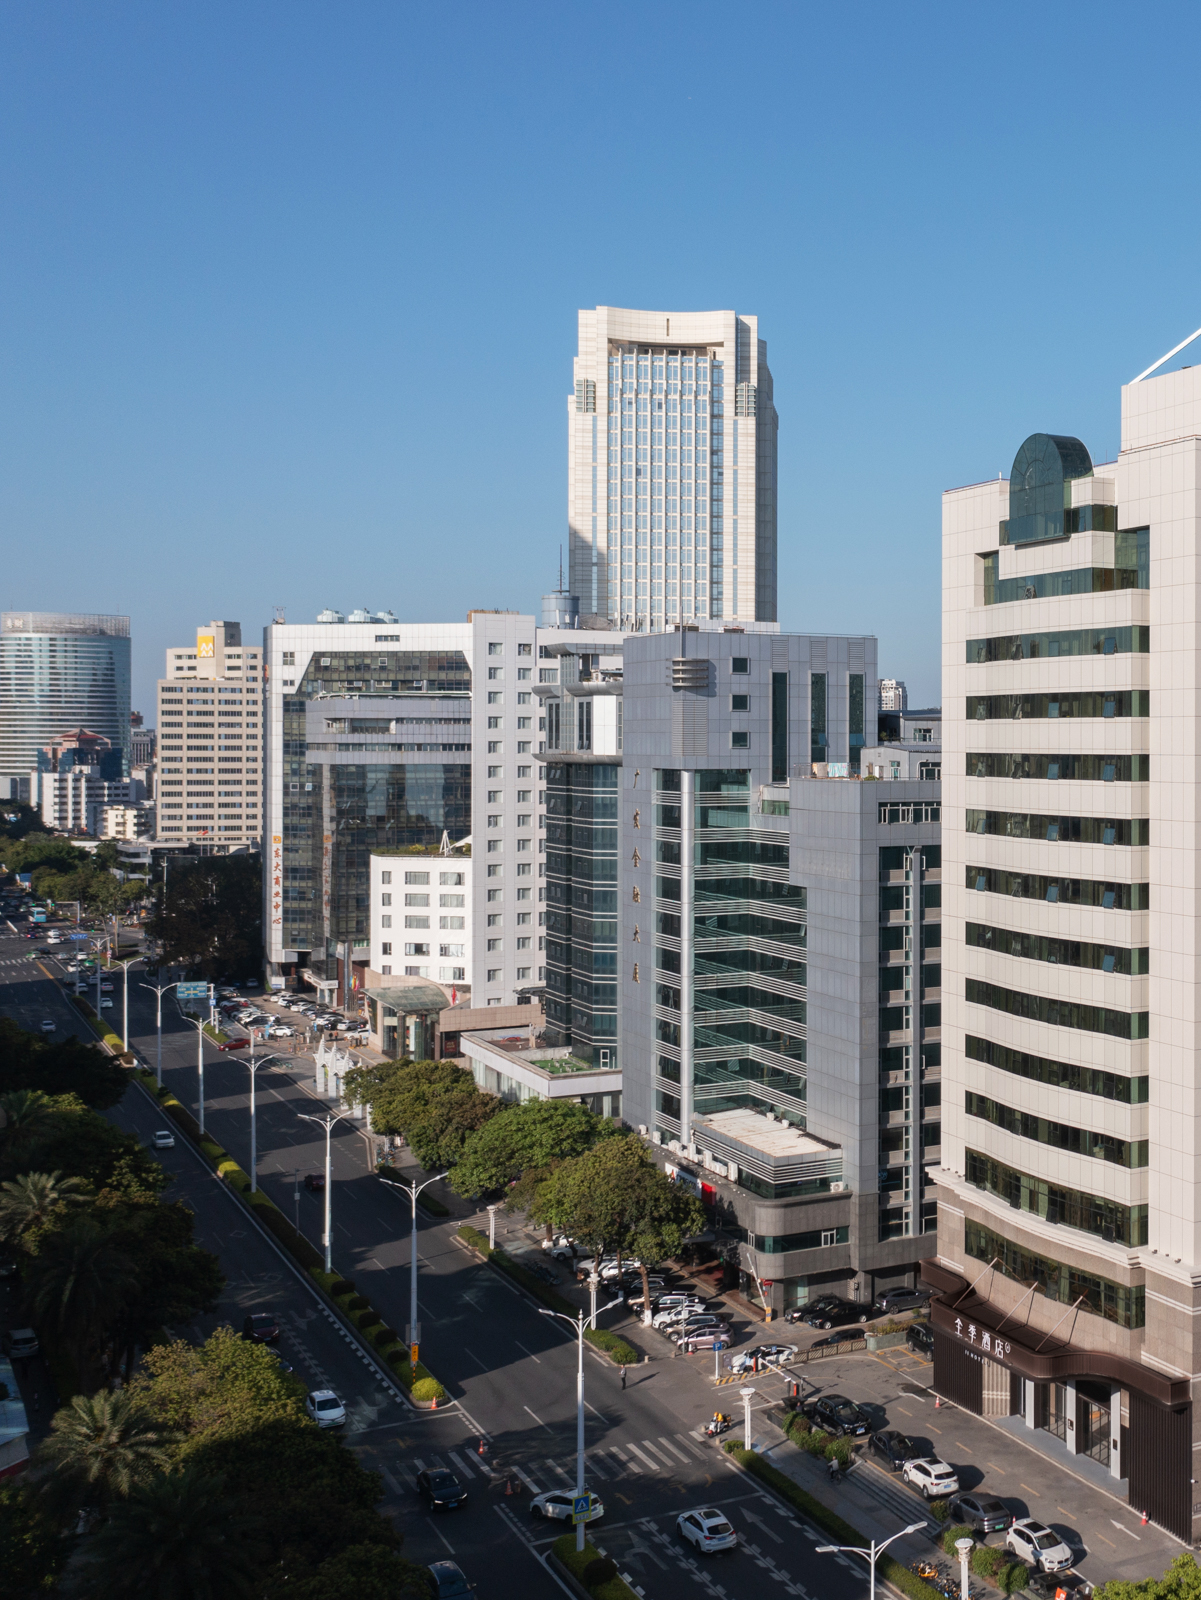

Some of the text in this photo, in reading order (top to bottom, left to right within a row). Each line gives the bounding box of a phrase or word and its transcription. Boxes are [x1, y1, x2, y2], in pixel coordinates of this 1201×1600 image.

[273, 847, 281, 924] 东大商业中心
[955, 1318, 1004, 1359] 全季酒店
